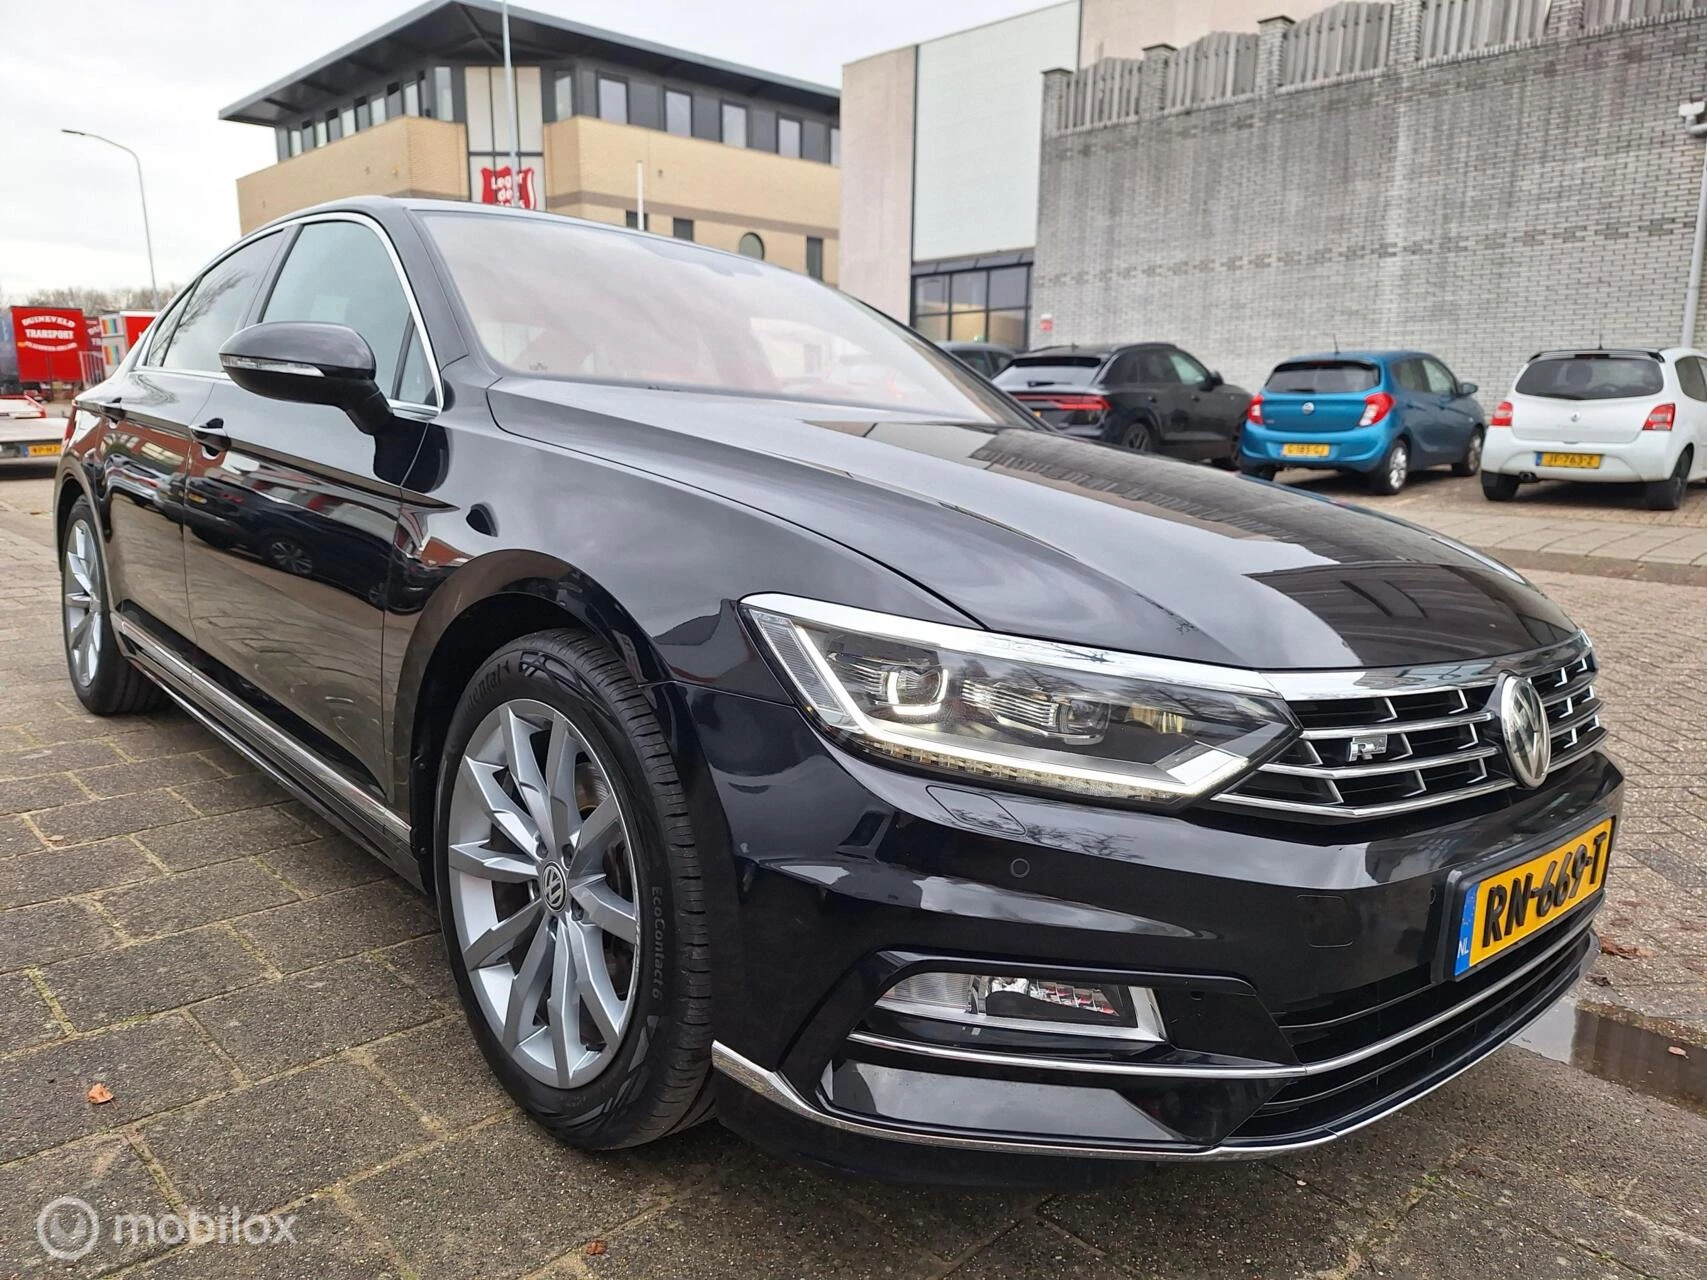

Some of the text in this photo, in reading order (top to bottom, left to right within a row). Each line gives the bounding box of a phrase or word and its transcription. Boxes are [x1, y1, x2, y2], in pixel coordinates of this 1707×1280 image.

[25, 329, 75, 339] TRANSPORT
[1482, 831, 1607, 948] RN-669-T
[1457, 936, 1469, 958] NL
